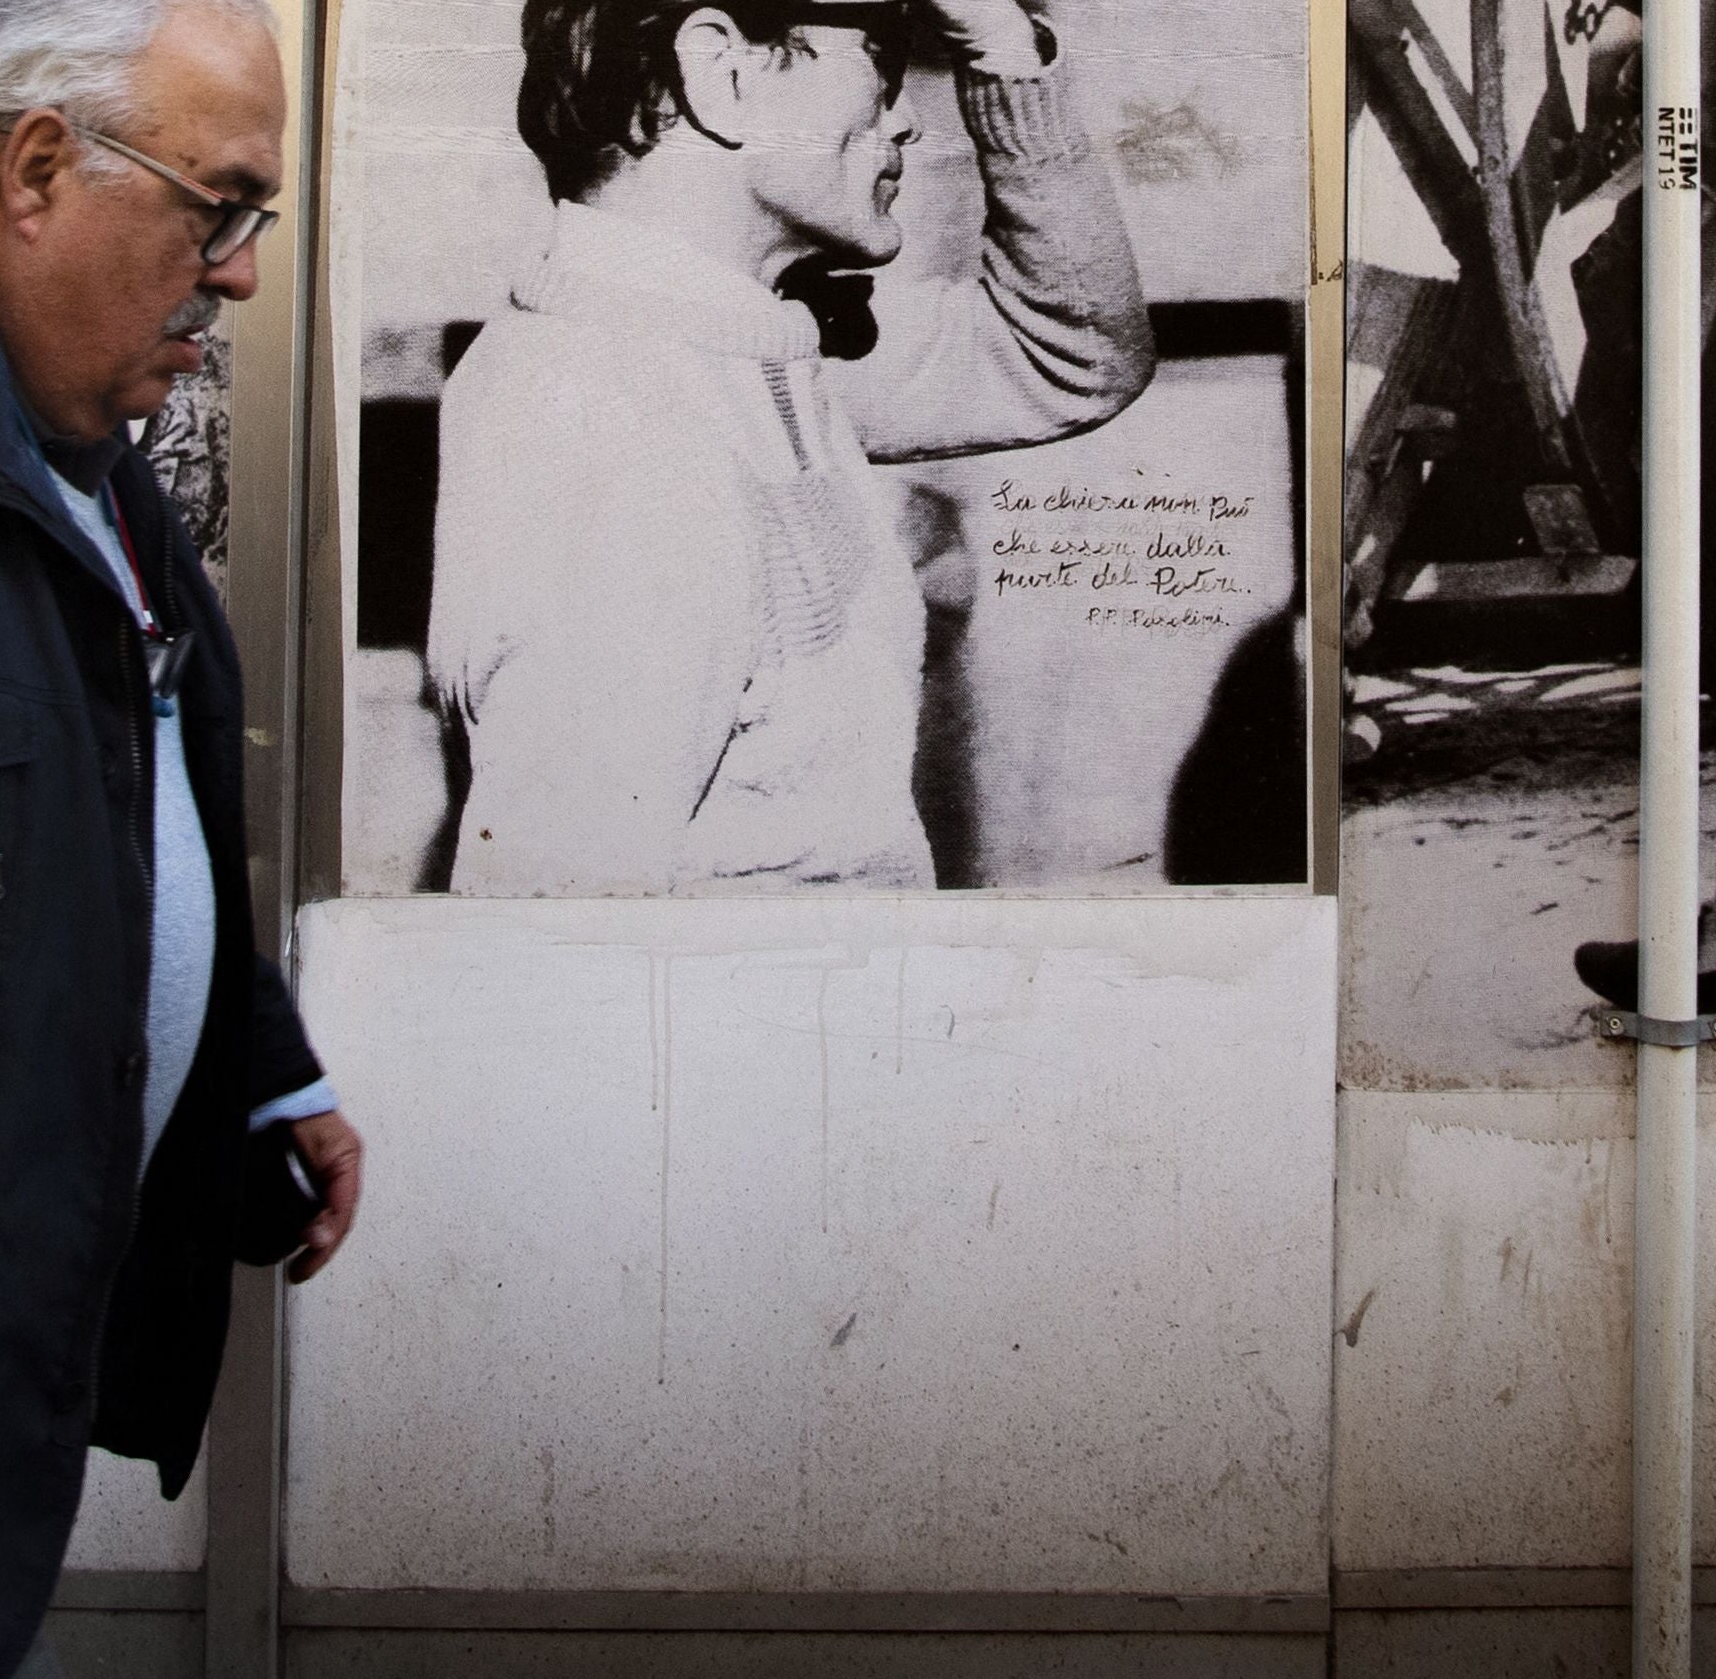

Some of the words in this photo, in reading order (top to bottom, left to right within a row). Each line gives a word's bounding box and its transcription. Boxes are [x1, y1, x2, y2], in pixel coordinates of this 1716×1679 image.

[1658, 107, 1676, 161] NTET
[1679, 138, 1699, 190] TIM
[1143, 494, 1200, 511] non
[992, 531, 1041, 556] che
[994, 561, 1080, 597] parte
[1092, 563, 1139, 589] del
